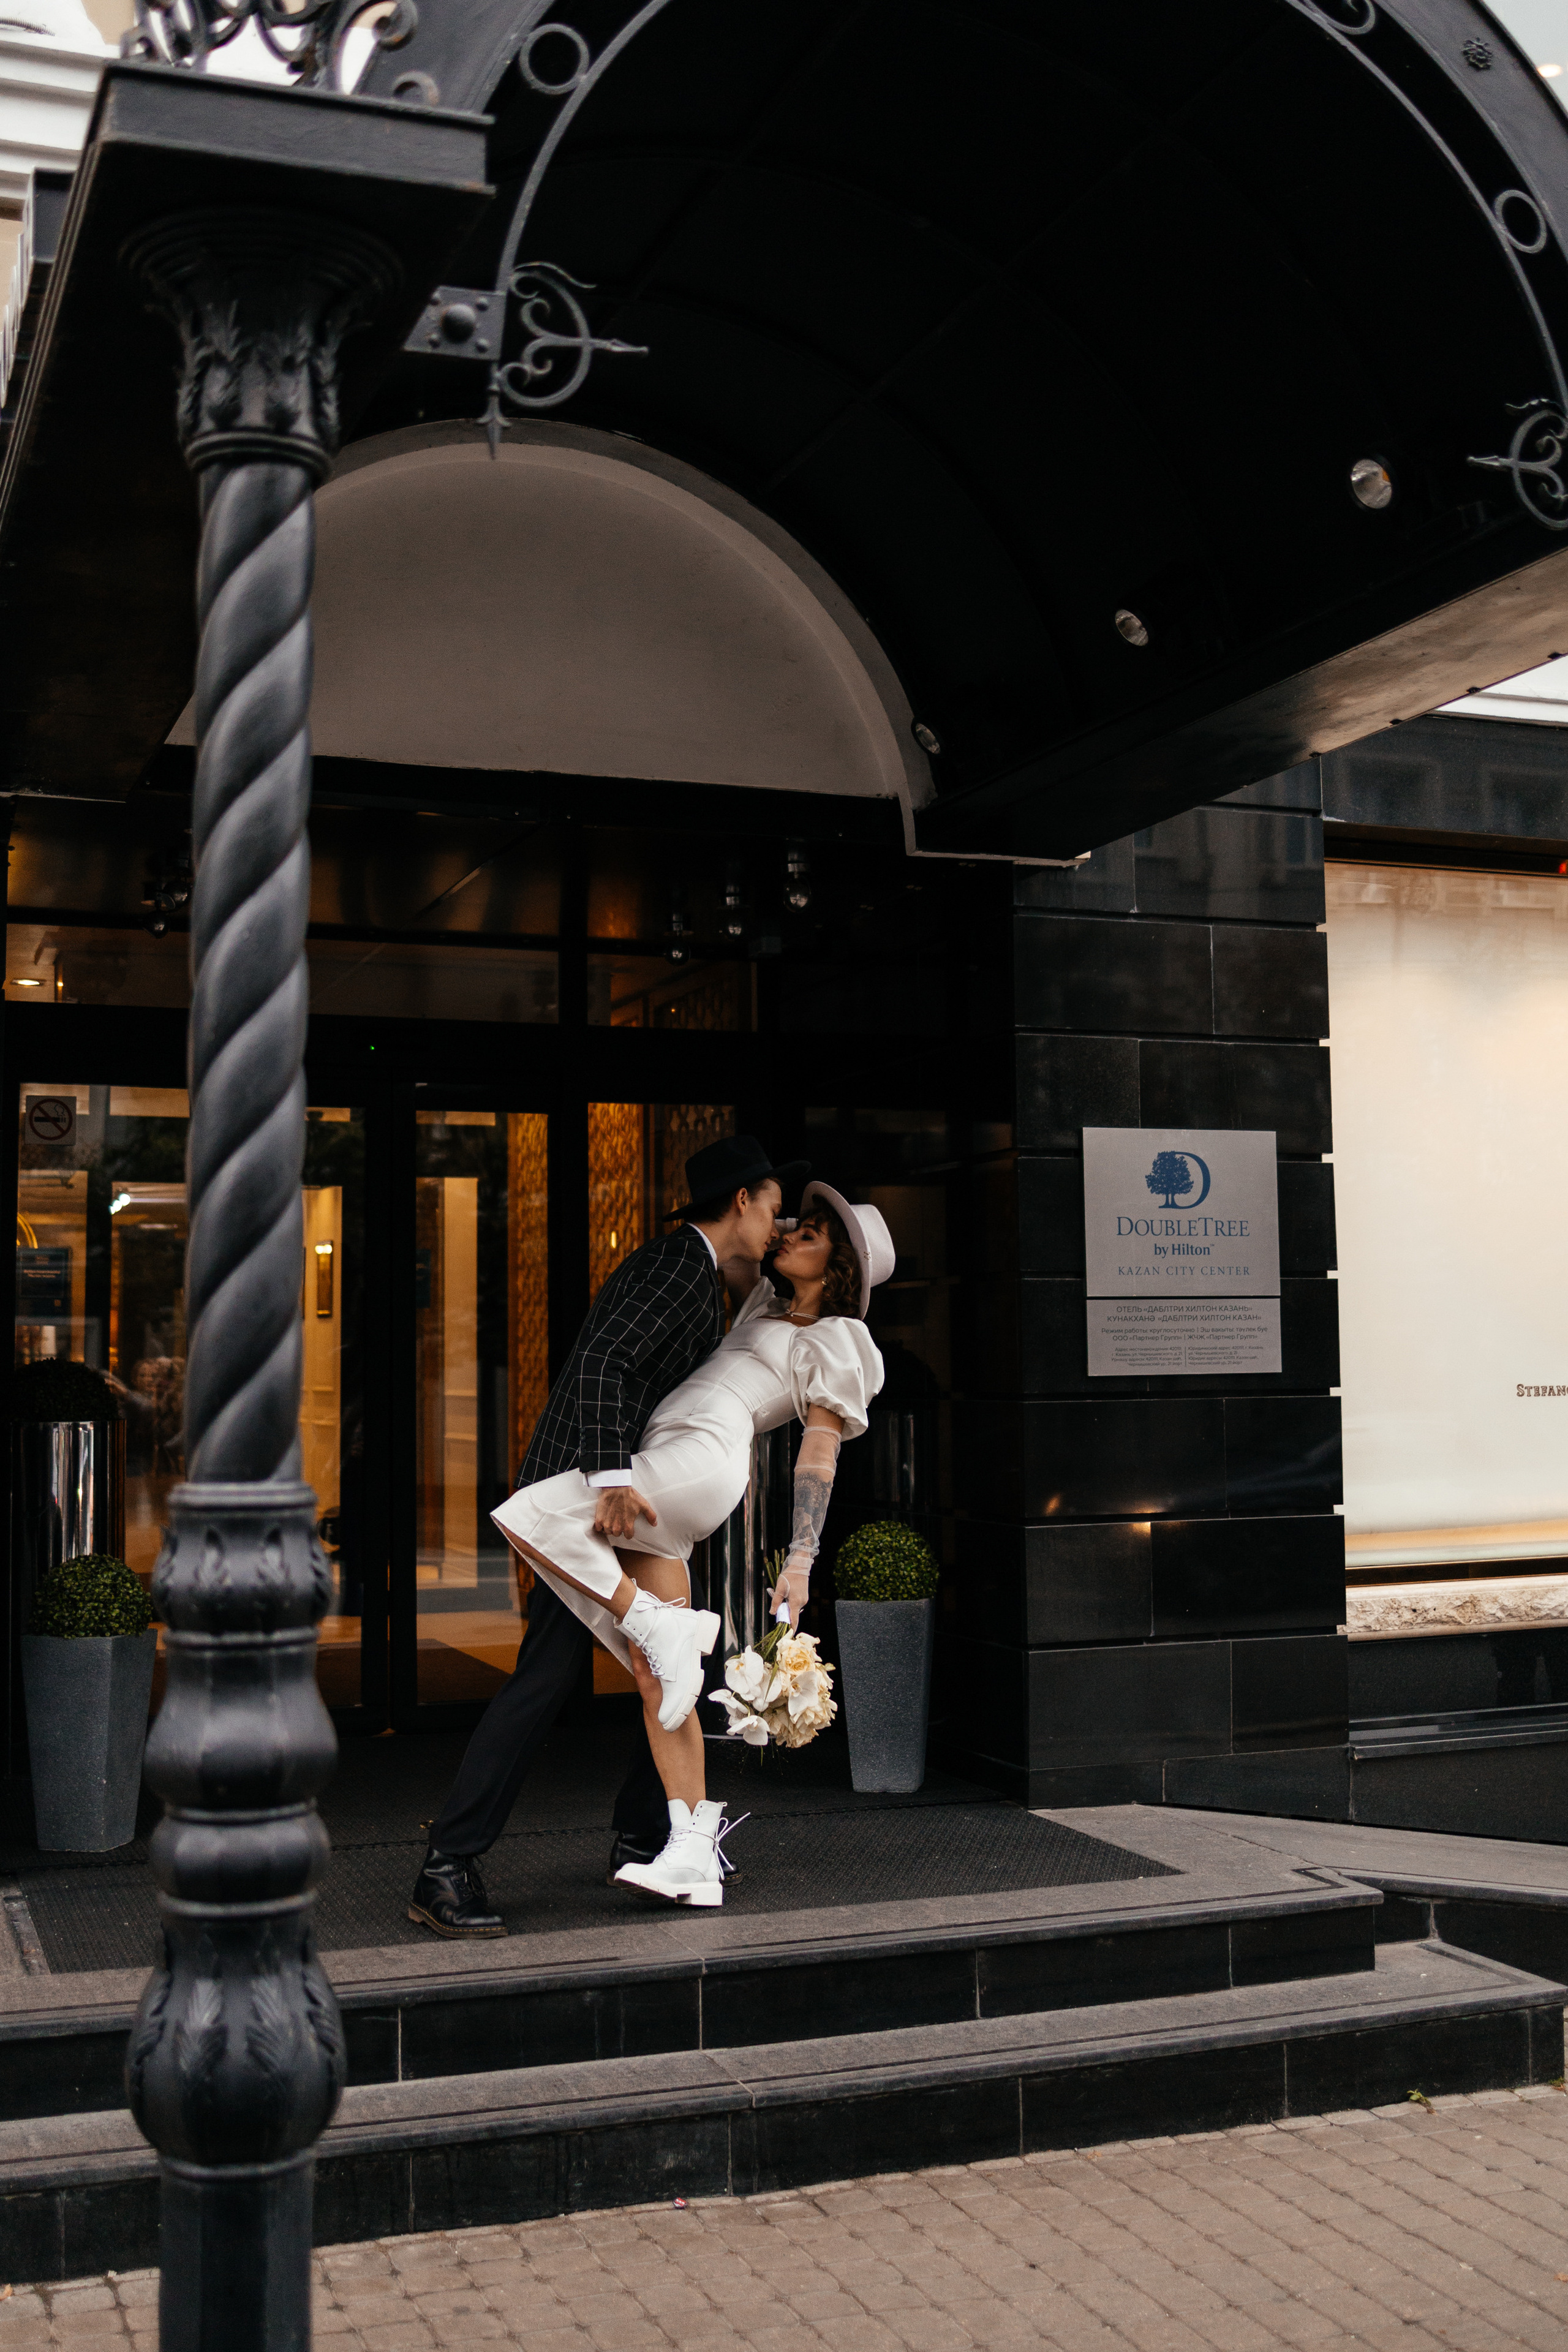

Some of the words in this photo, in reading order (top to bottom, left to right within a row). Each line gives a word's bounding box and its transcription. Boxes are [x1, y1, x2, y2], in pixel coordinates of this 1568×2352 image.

[1154, 1243, 1169, 1258] by
[1118, 1266, 1160, 1275] KAZAN
[1166, 1266, 1195, 1275] CITY
[1200, 1266, 1250, 1275] CENTER
[1517, 1384, 1568, 1397] STEFAN
